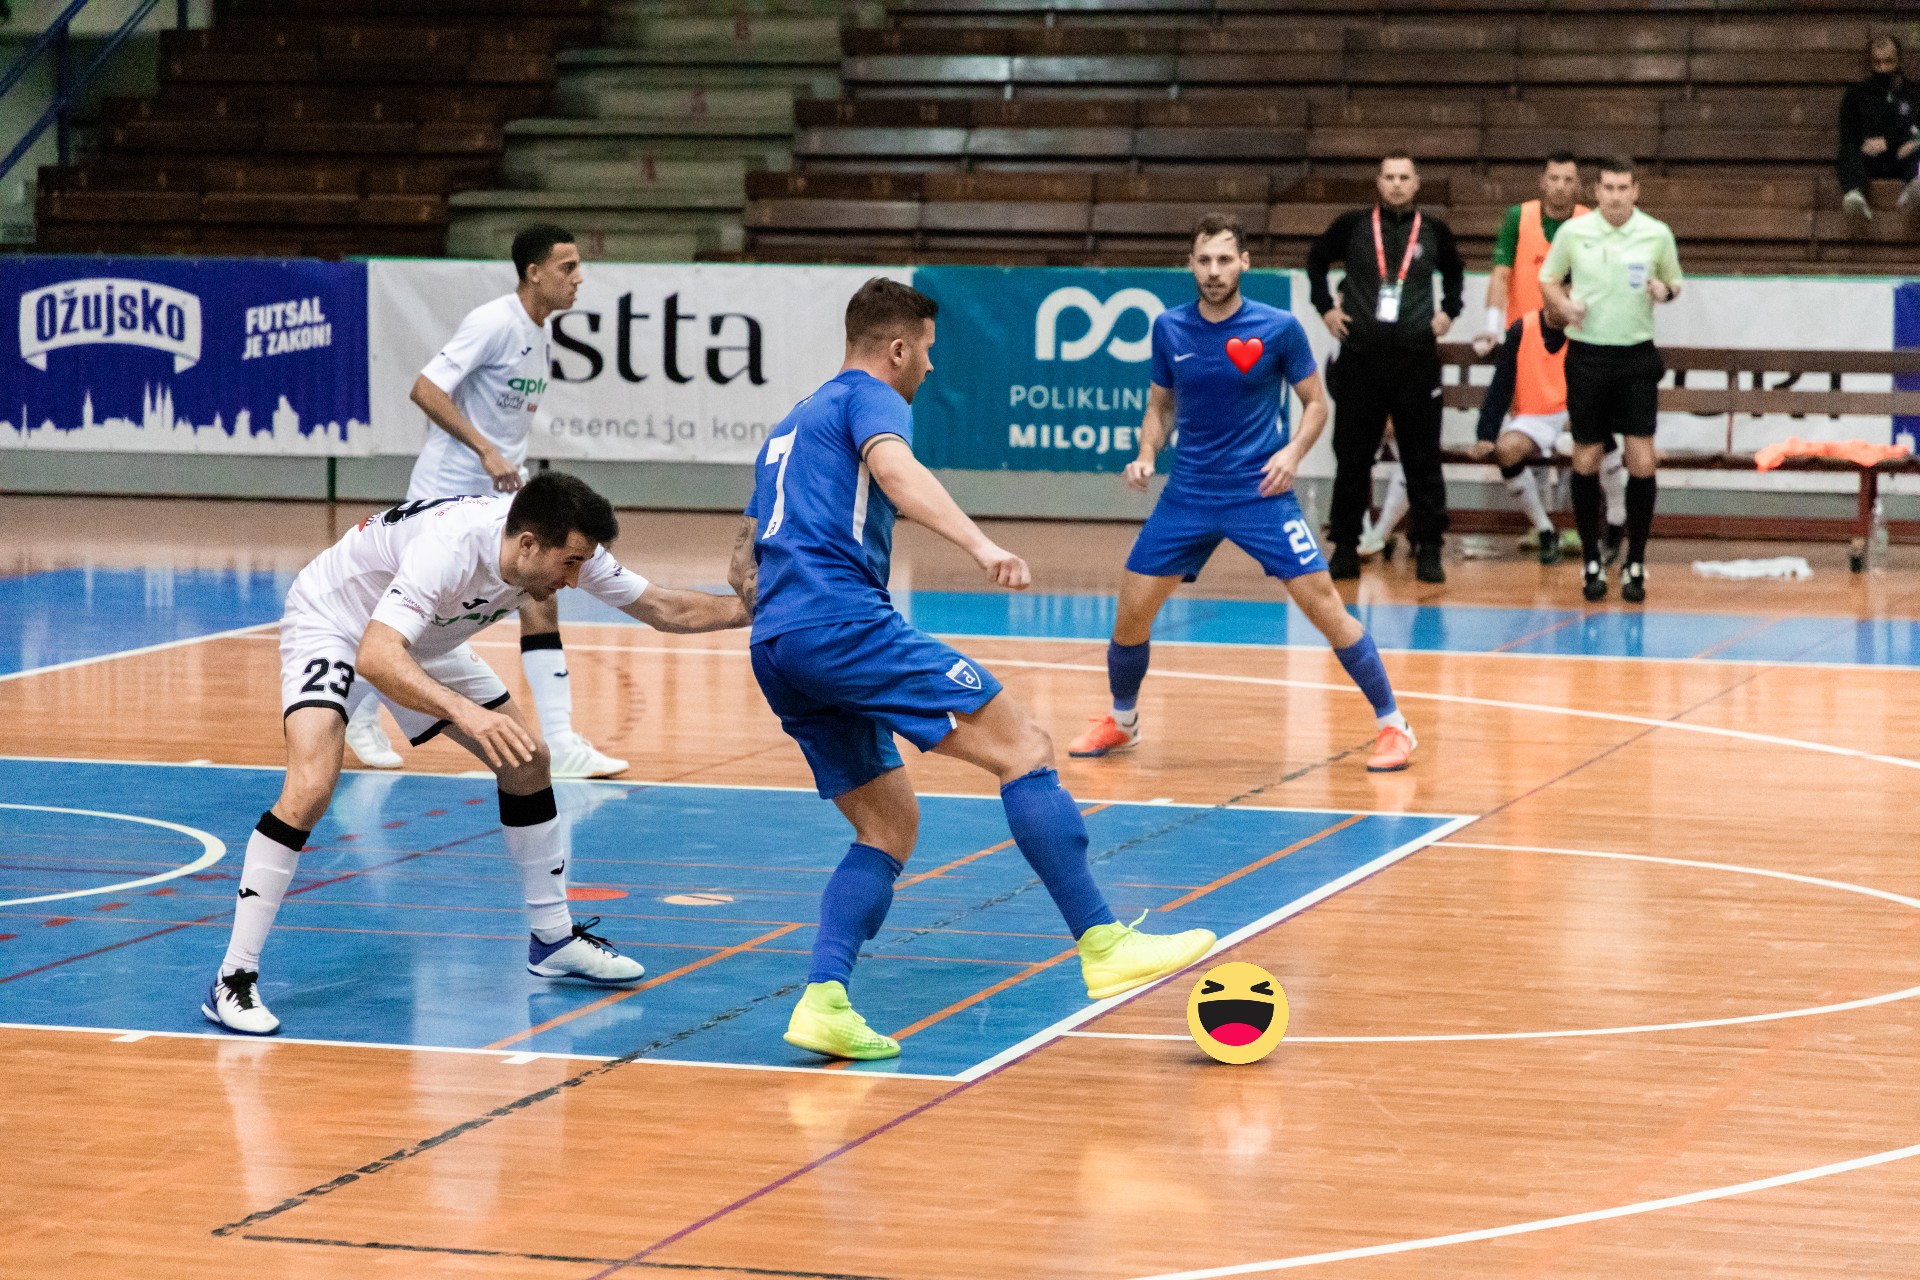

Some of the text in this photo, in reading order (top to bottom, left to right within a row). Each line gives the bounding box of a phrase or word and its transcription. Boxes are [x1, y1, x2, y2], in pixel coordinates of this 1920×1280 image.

[36, 285, 186, 342] Ožujsko
[245, 296, 325, 334] FUTSAL
[242, 322, 332, 360] JE ZAKON!
[551, 292, 768, 386] stta
[550, 415, 777, 444] esencija kon
[765, 424, 798, 540] 7
[299, 657, 355, 699] 23
